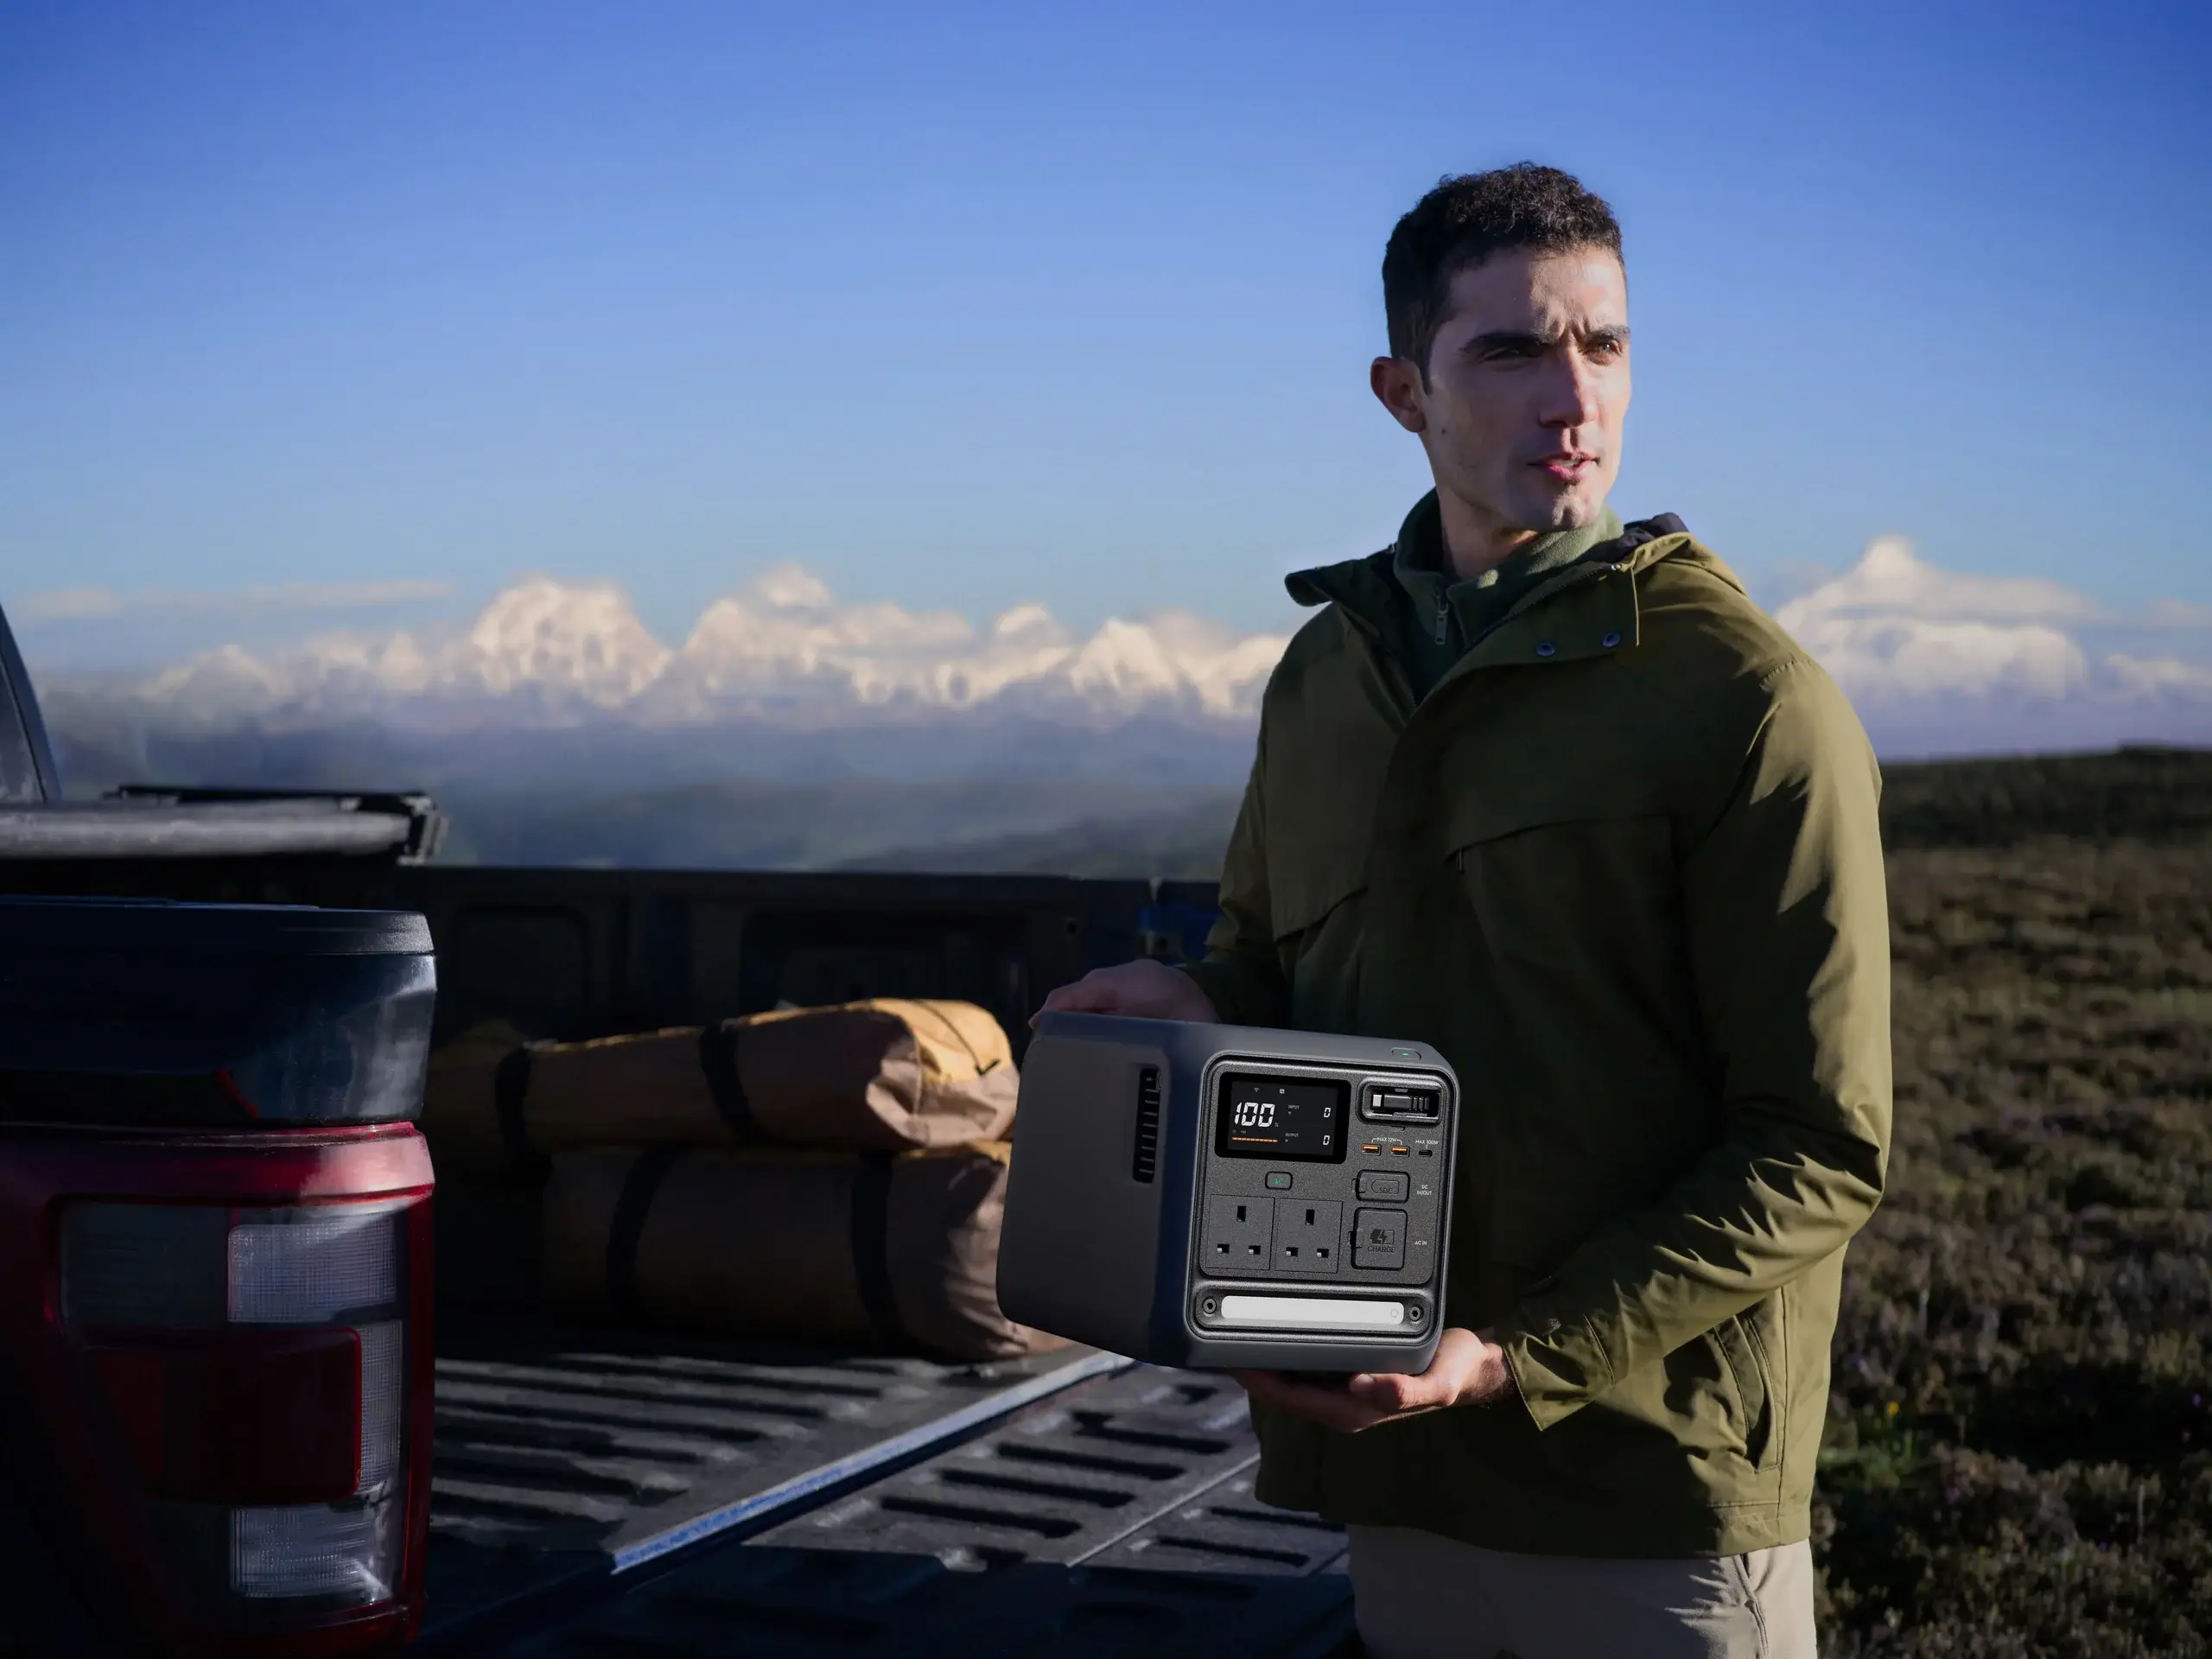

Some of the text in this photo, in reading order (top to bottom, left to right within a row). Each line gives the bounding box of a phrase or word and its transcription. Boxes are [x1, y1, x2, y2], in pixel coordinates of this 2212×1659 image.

[1234, 1102, 1275, 1128] 100
[1323, 1107, 1332, 1118] 0
[1322, 1135, 1331, 1146] 0
[1367, 1245, 1395, 1254] CHARGE
